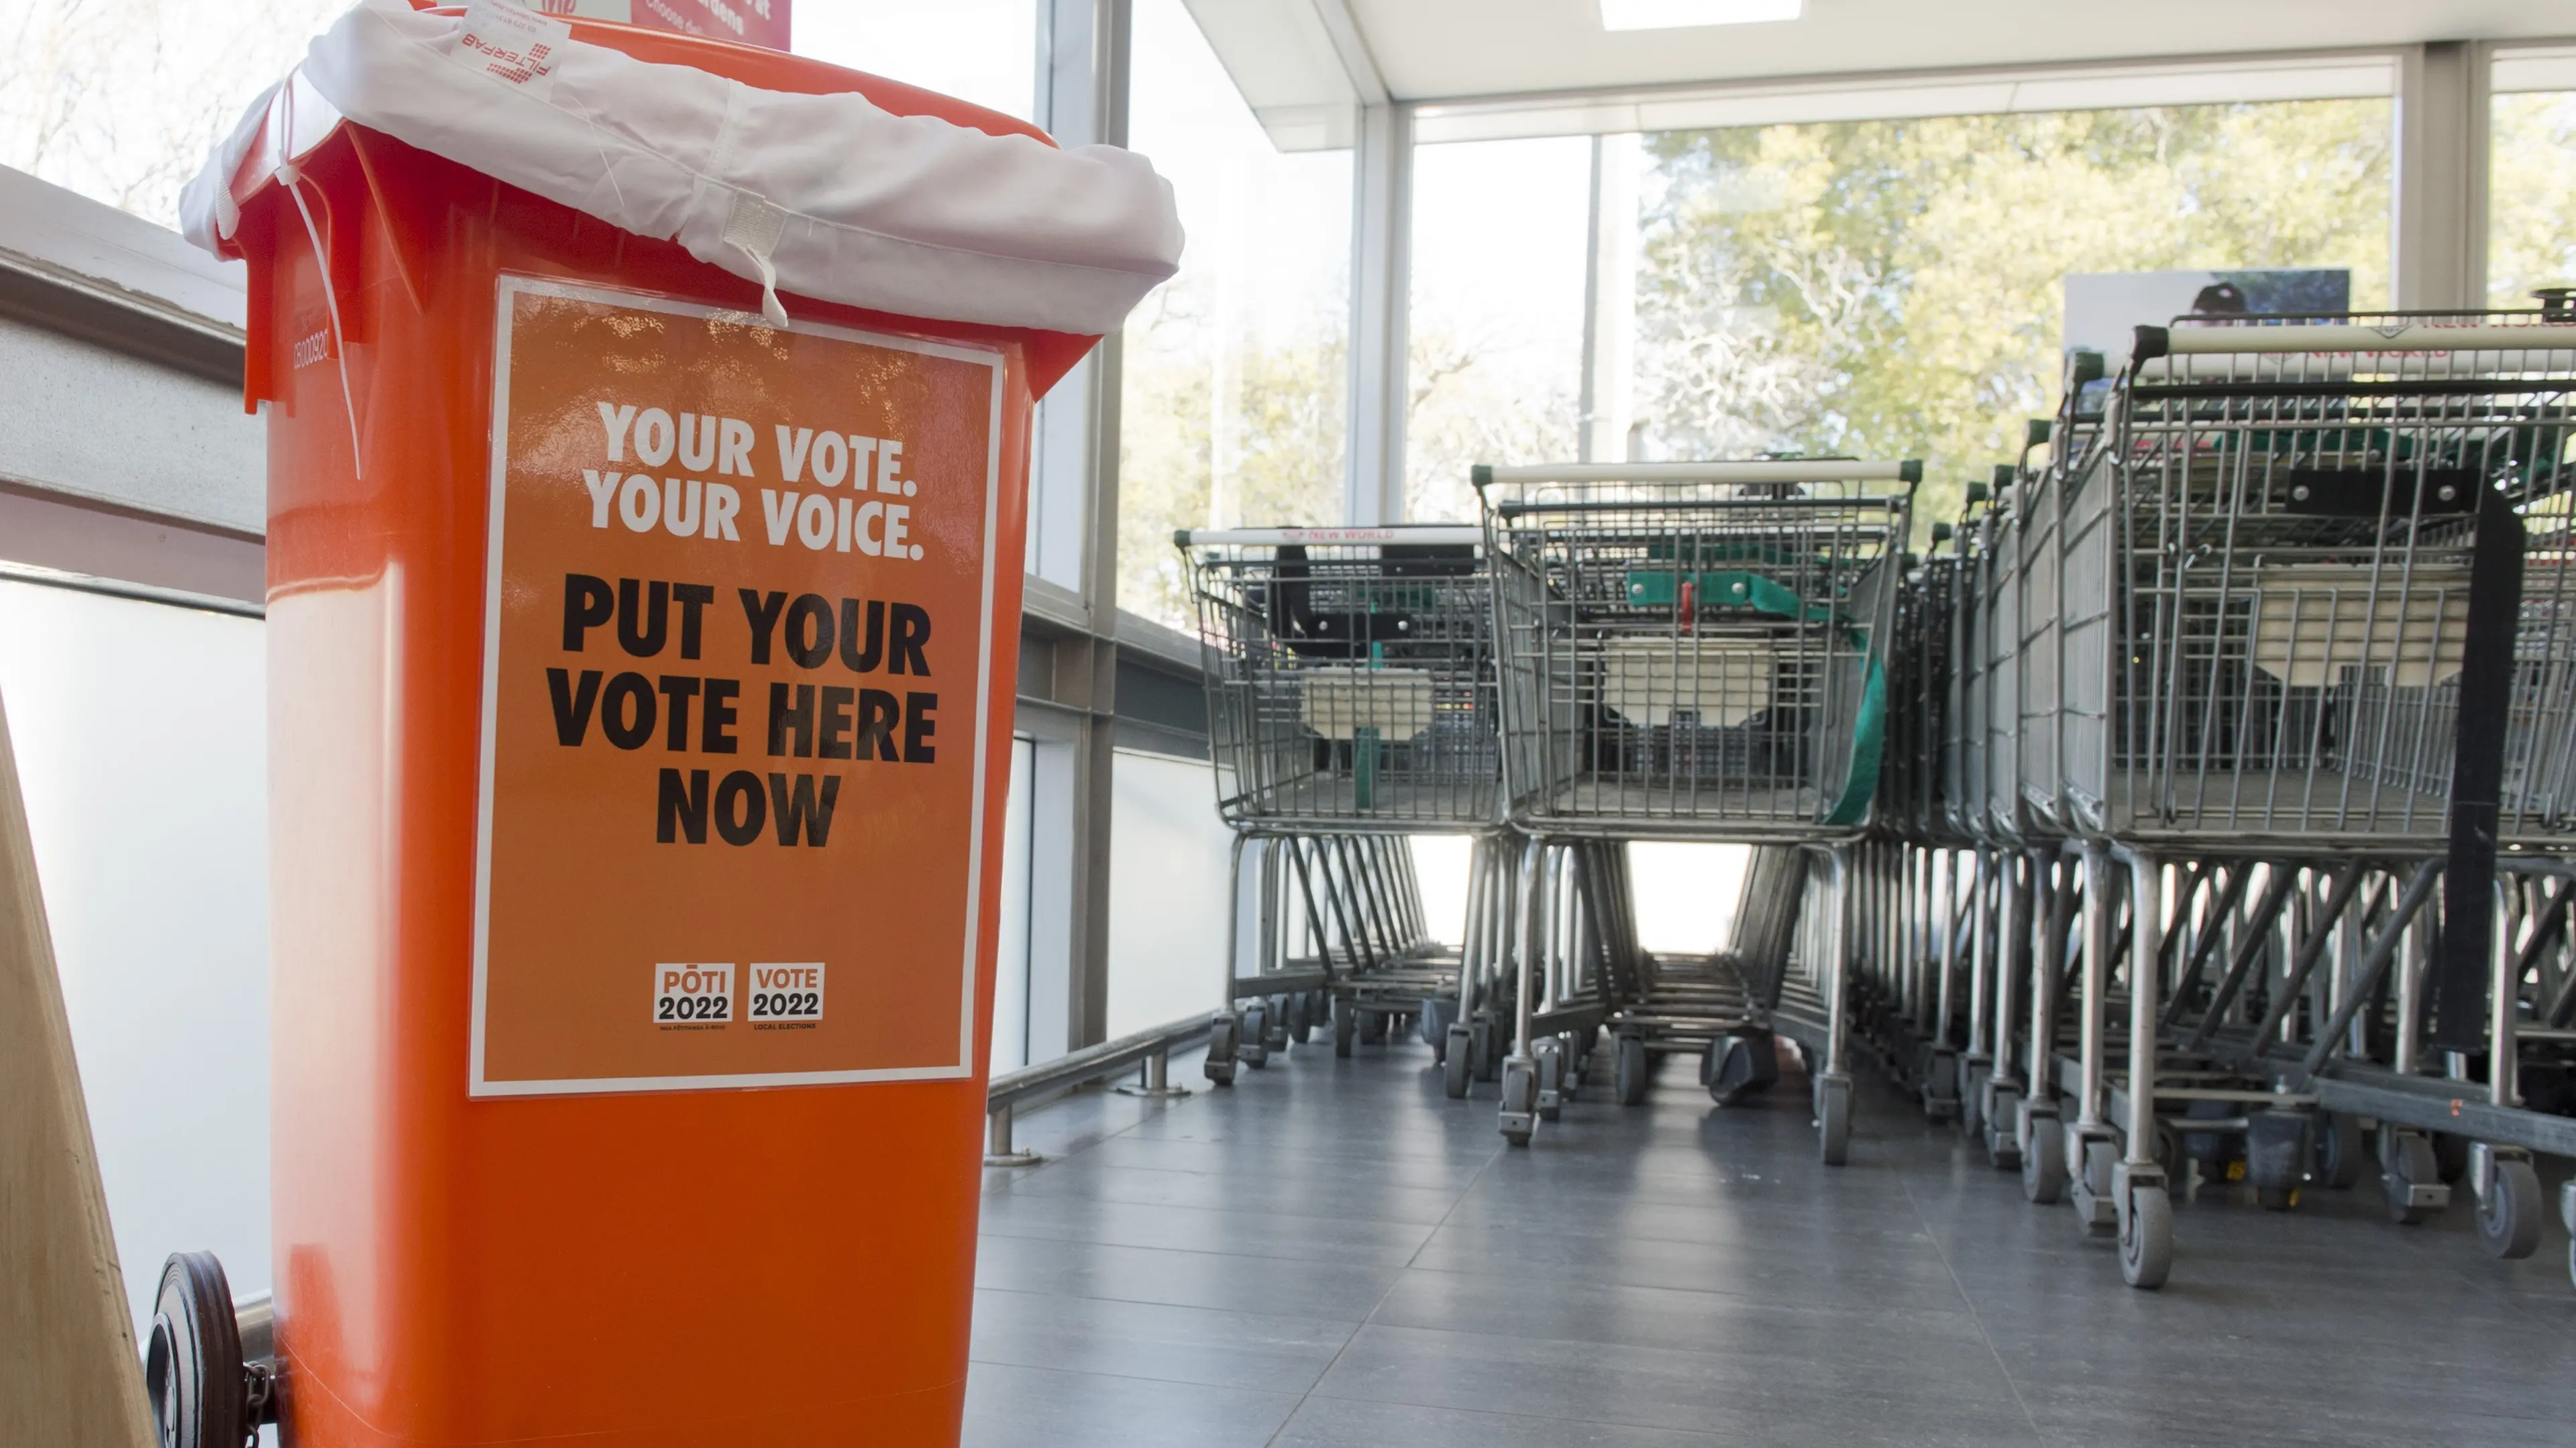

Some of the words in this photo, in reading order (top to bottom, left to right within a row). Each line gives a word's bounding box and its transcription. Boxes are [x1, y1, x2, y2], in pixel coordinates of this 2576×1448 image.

[462, 34, 551, 76] FILTERFAB
[596, 401, 755, 477] YOUR
[775, 425, 917, 497] VOTE.
[582, 468, 740, 541] YOUR
[761, 489, 924, 561] VOICE.
[562, 573, 714, 660] PUT
[738, 588, 931, 677] YOUR
[545, 667, 740, 755] VOTE
[767, 682, 938, 764] HERE
[656, 767, 841, 847] NOW
[659, 997, 728, 1020] 2022
[663, 964, 726, 994] PŌTI
[753, 993, 818, 1016] 2022
[756, 968, 818, 989] VOTE
